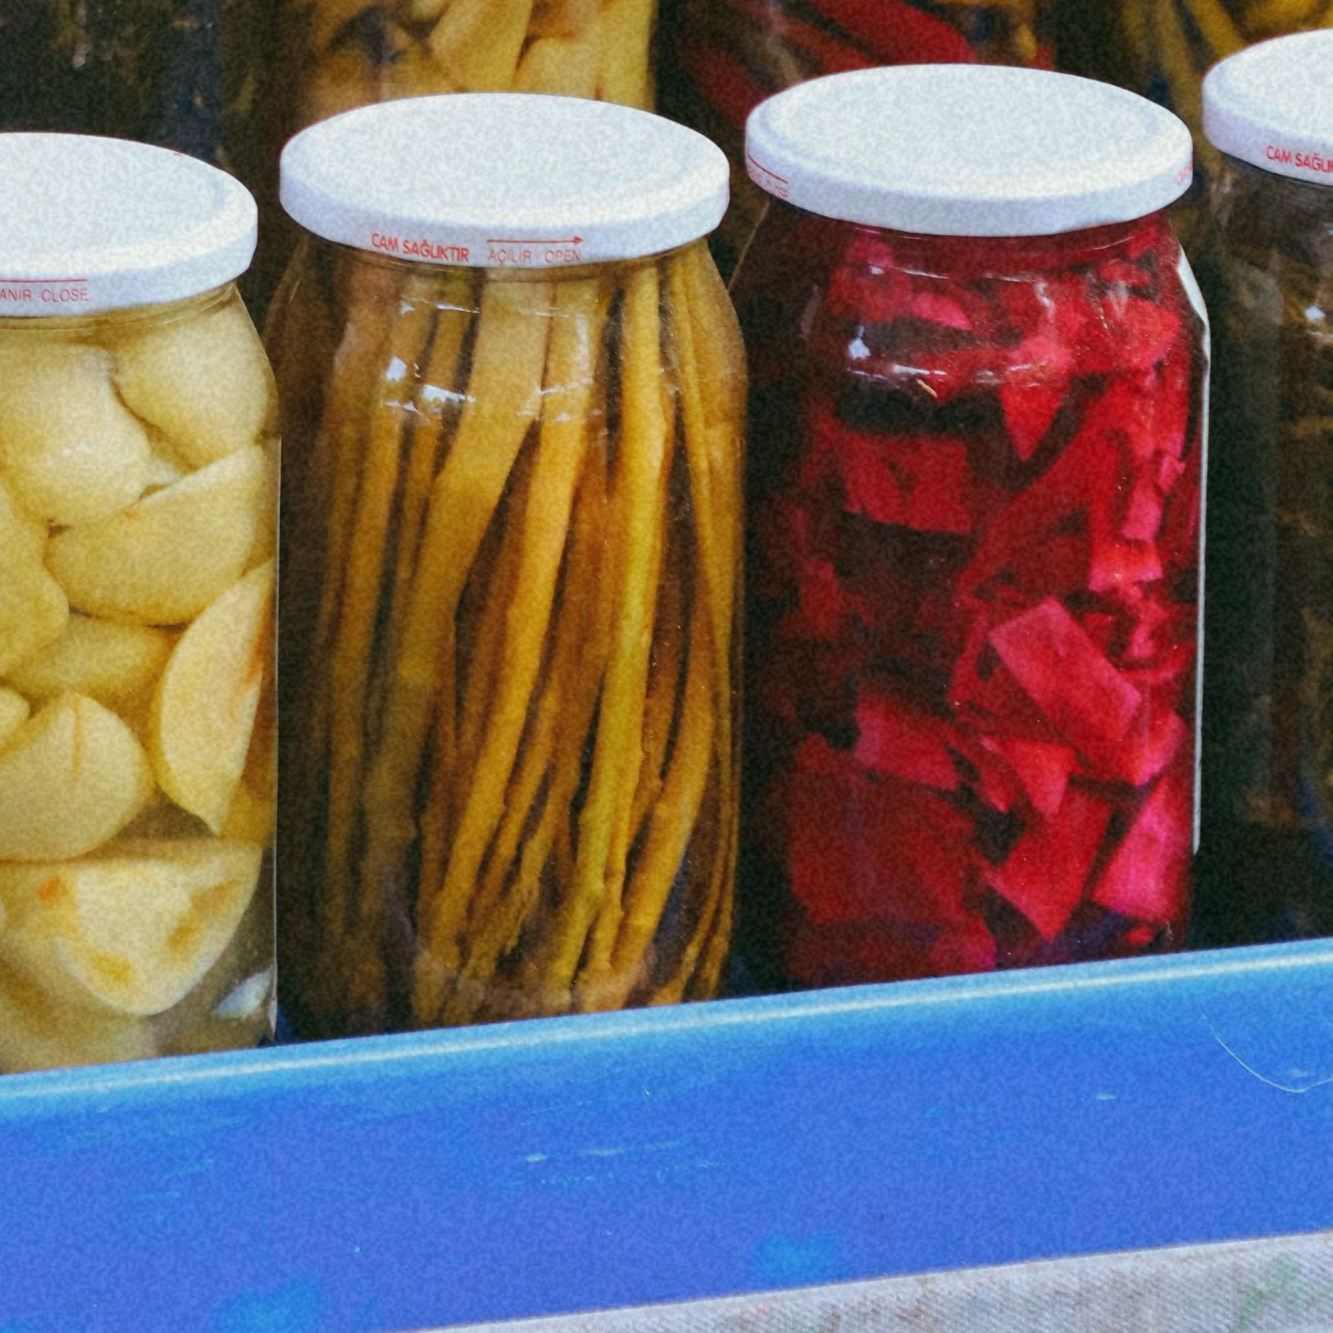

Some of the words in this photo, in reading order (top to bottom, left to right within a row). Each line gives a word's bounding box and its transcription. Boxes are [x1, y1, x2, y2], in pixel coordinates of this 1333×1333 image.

[1266, 145, 1292, 164] CAM
[371, 232, 399, 253] CAM
[402, 239, 470, 263] SAĞLIKTIR
[488, 248, 532, 266] AÇILIR
[544, 248, 582, 264] OPEN
